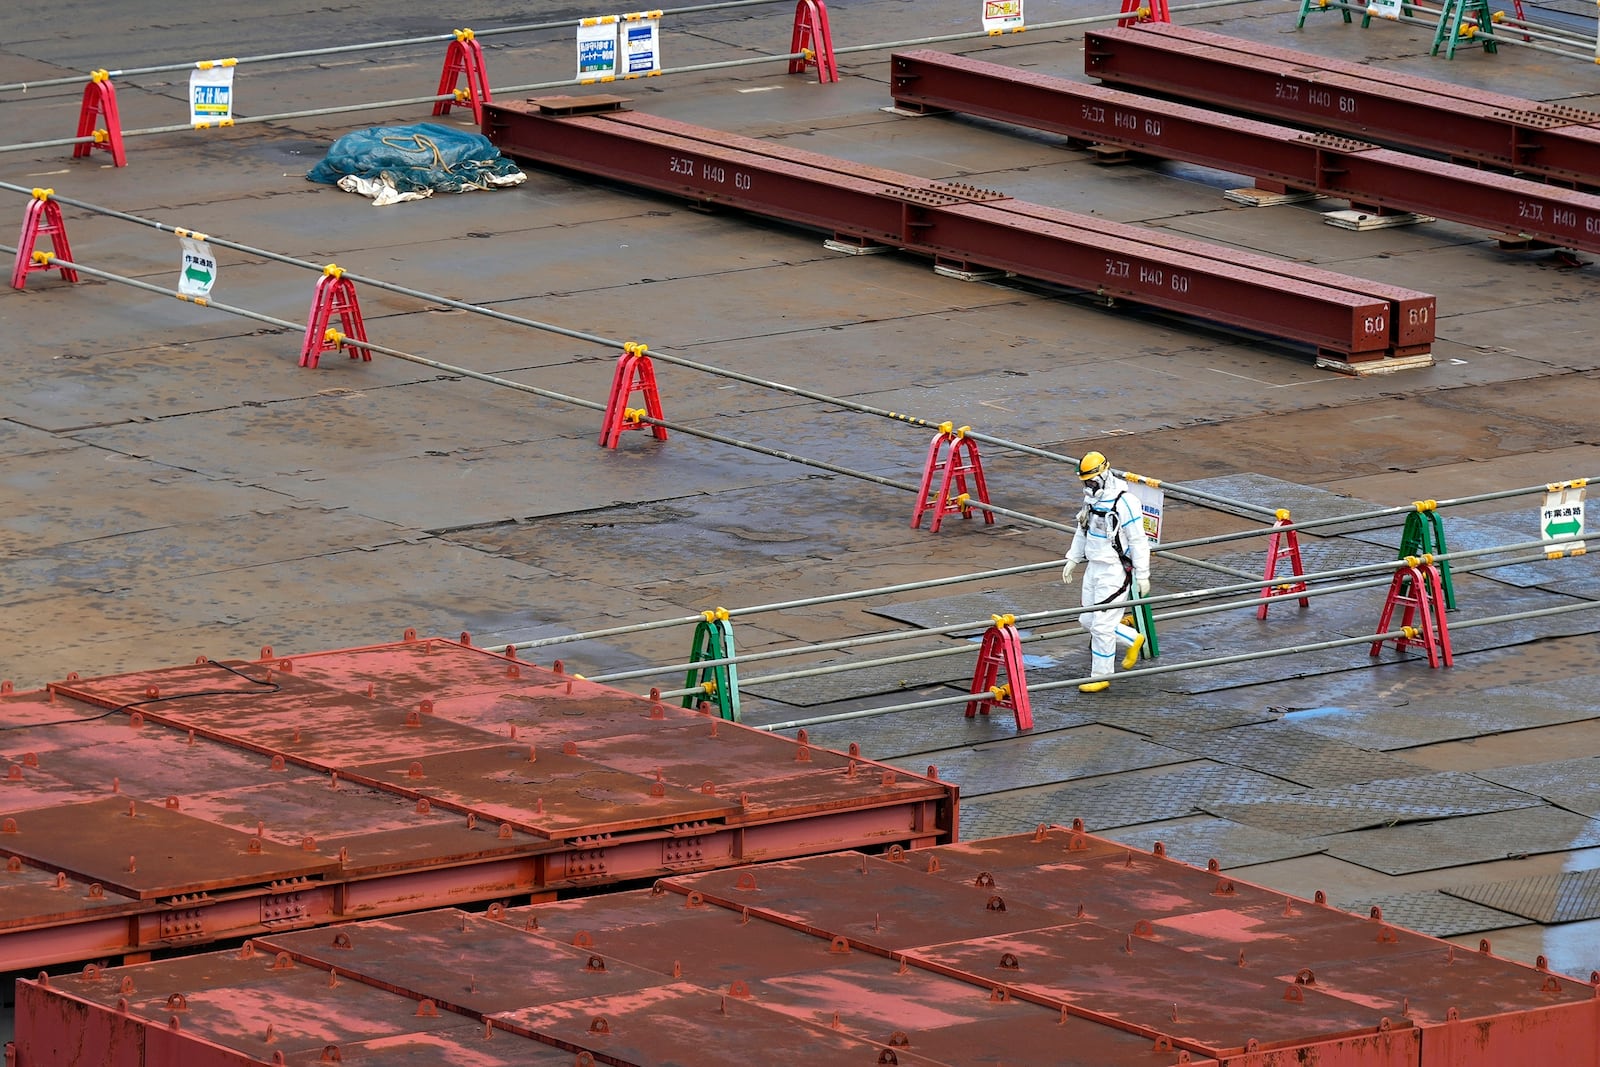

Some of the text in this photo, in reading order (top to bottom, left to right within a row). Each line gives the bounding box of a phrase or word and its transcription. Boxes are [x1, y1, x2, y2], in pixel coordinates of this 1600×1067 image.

[1308, 89, 1331, 107] H40
[1115, 112, 1137, 130] H40
[703, 164, 725, 183] H40
[1553, 208, 1577, 228] H40
[1140, 266, 1163, 286] H40
[1544, 506, 1581, 519] 作業通路
